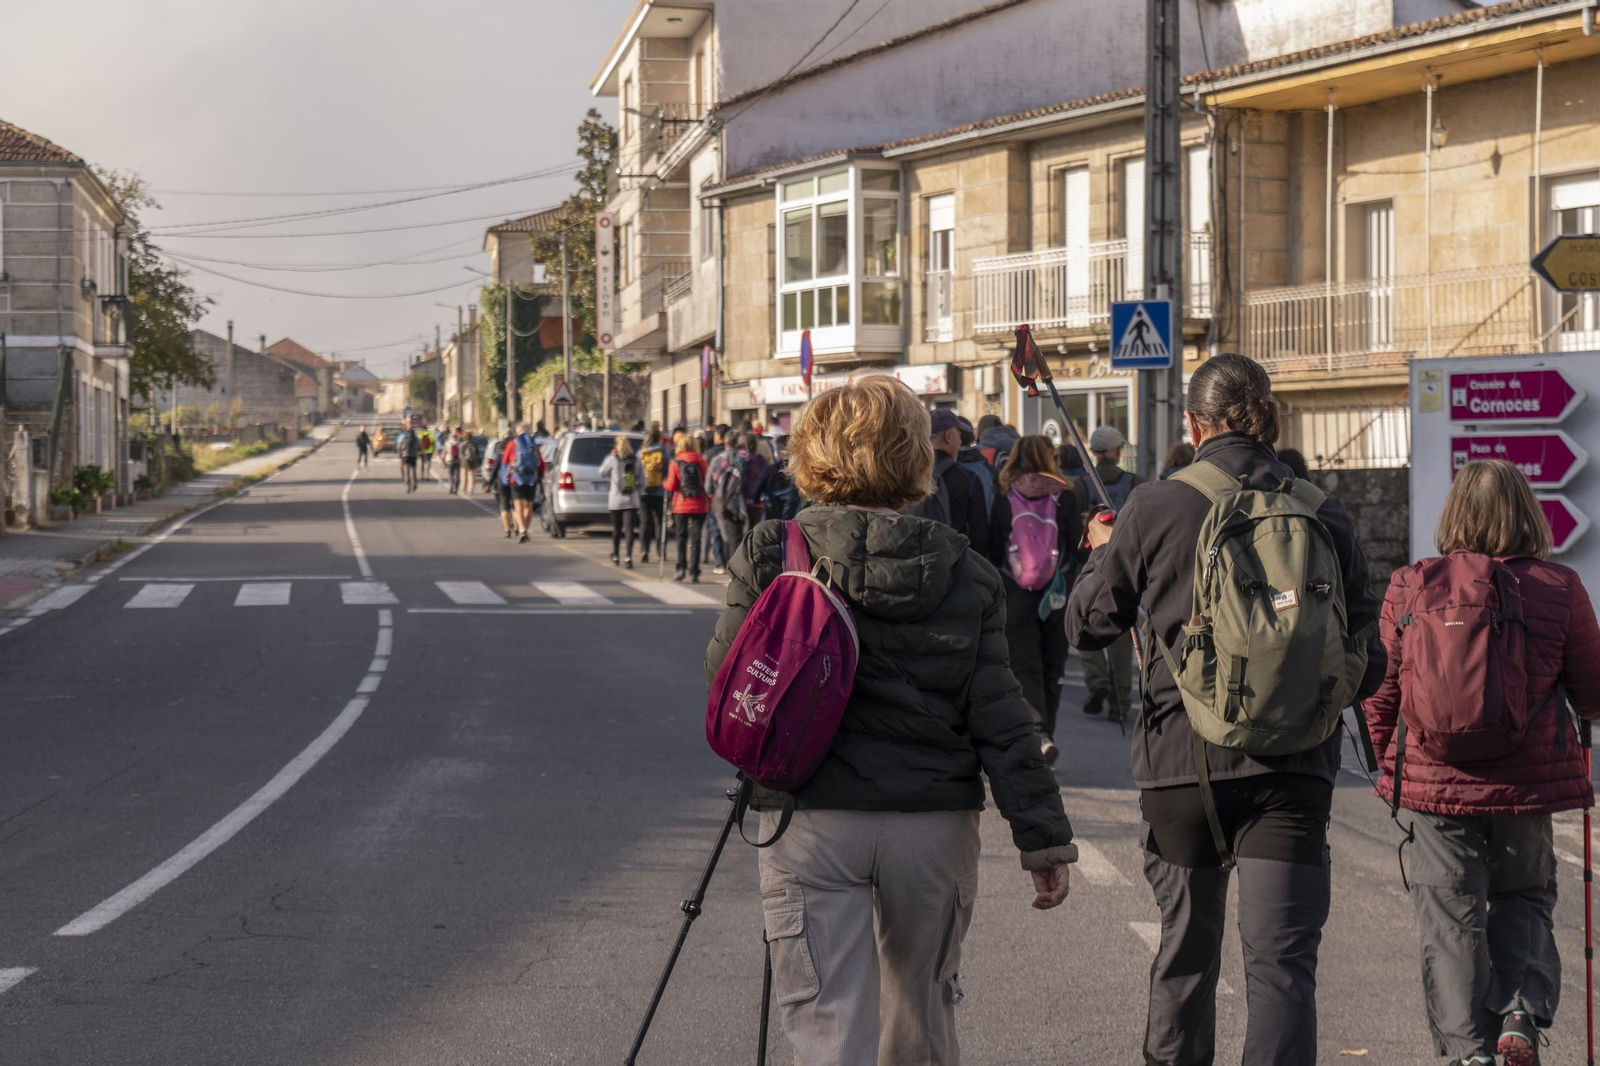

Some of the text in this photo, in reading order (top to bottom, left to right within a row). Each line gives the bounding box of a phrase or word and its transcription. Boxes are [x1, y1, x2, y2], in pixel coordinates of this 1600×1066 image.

[1469, 378, 1521, 391] Cruceiro de
[1469, 396, 1540, 414] Cornoces
[1470, 442, 1507, 454] Pazo de
